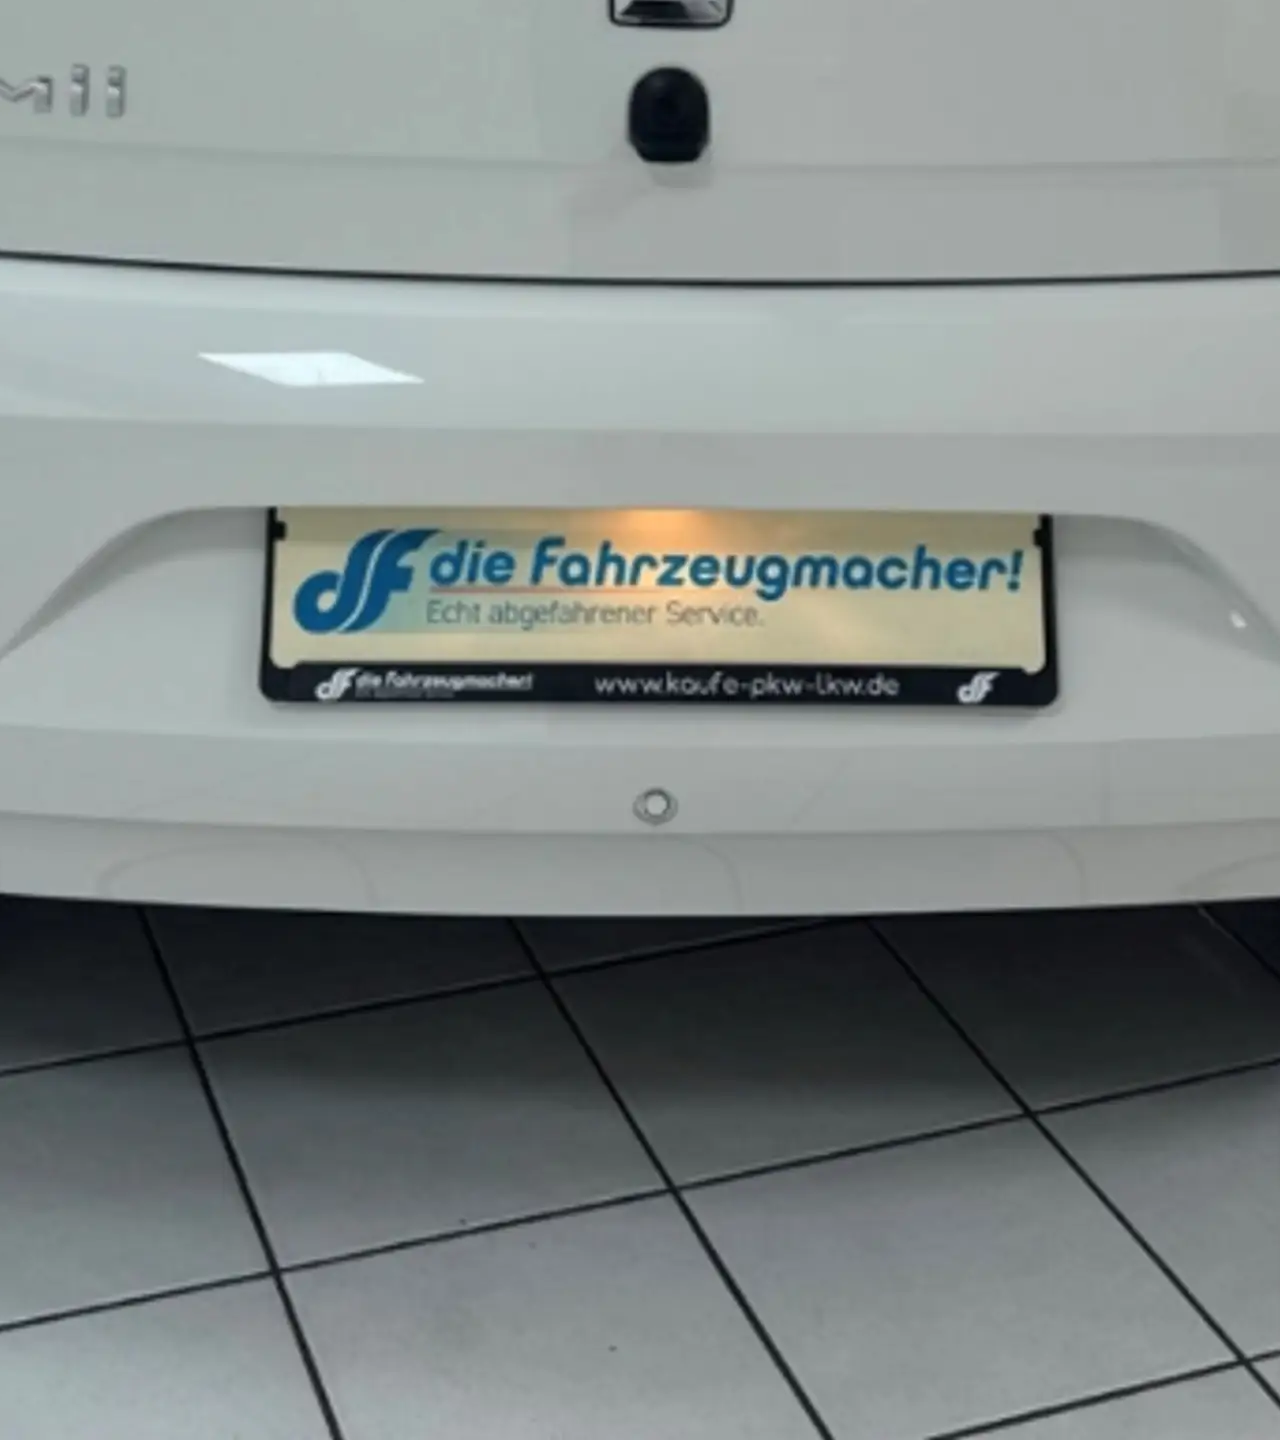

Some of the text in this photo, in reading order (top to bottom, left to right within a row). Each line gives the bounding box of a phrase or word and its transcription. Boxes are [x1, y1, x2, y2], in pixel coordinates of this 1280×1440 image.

[429, 536, 1024, 602] die Fahrzeugmacher!
[426, 599, 765, 632] Echt abgefahrener Service.
[594, 671, 901, 699] www.kaufe-pkw-lkw.de
